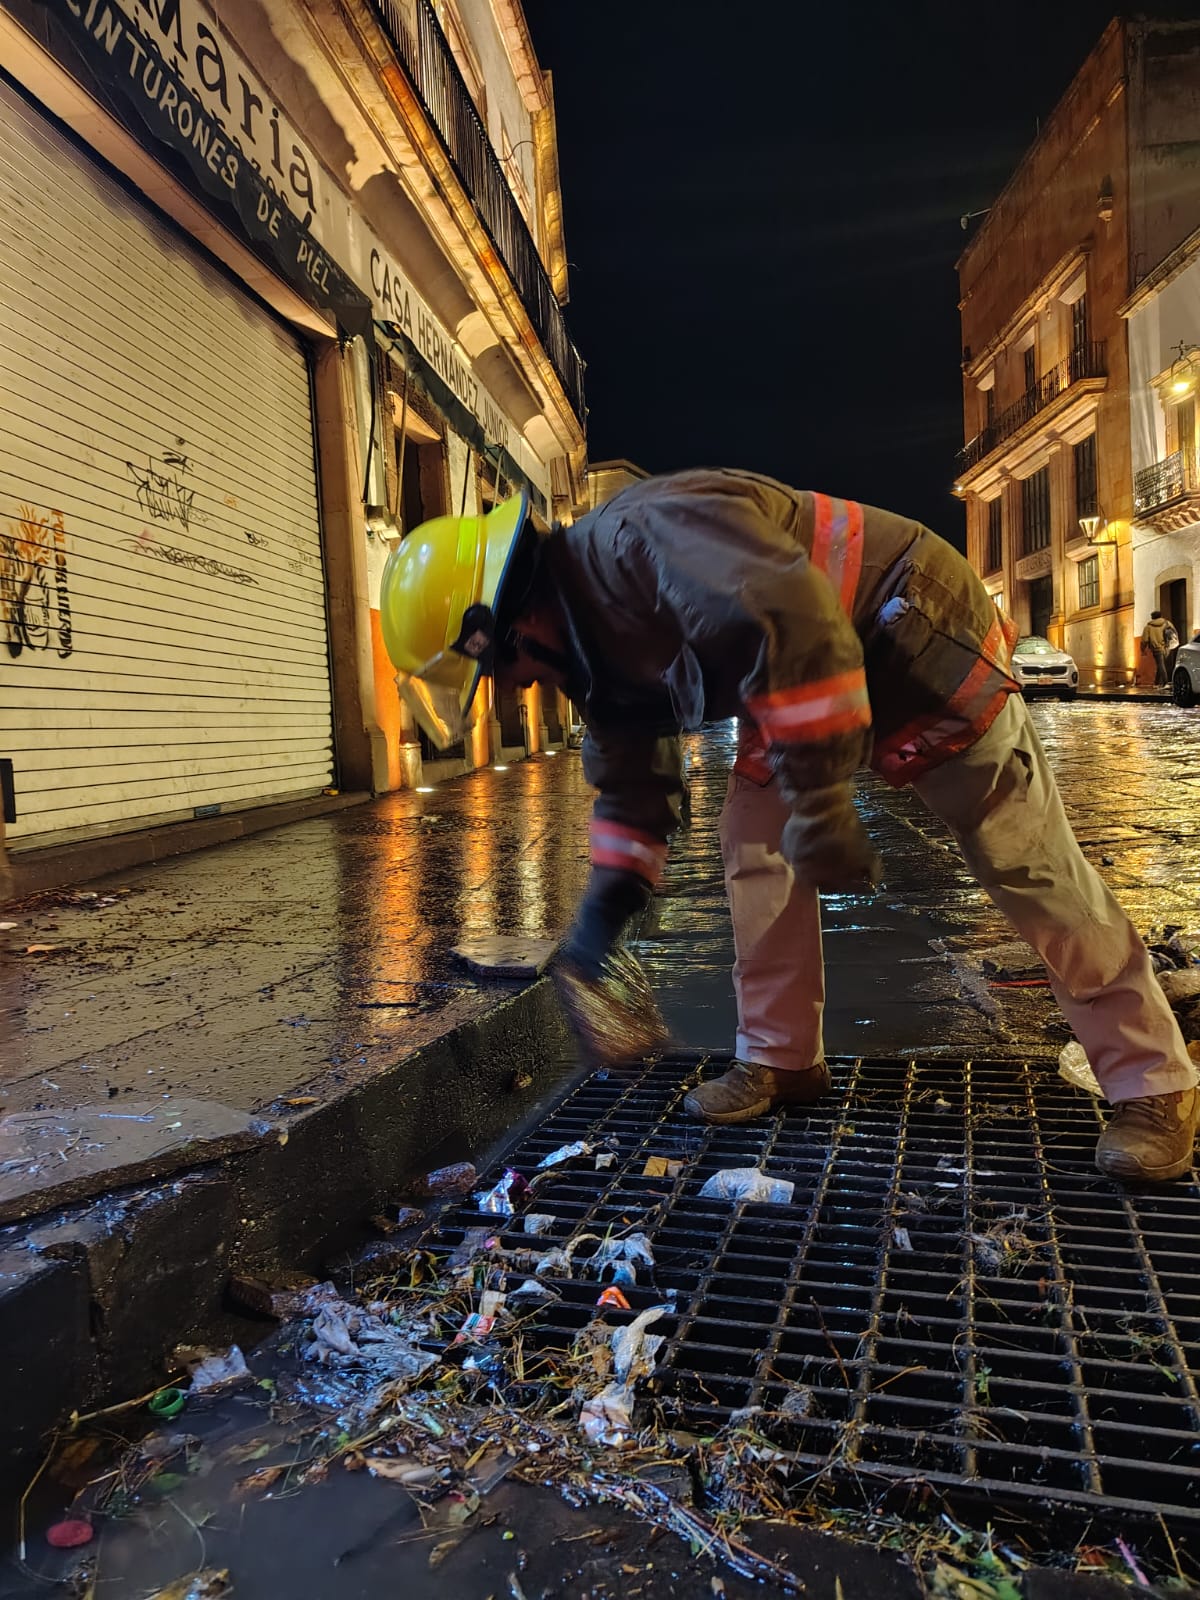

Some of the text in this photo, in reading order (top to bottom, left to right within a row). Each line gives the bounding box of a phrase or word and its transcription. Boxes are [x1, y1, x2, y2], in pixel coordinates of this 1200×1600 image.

[257, 191, 281, 239] DE
[296, 239, 330, 295] PIEL
[370, 248, 413, 338] CASA
